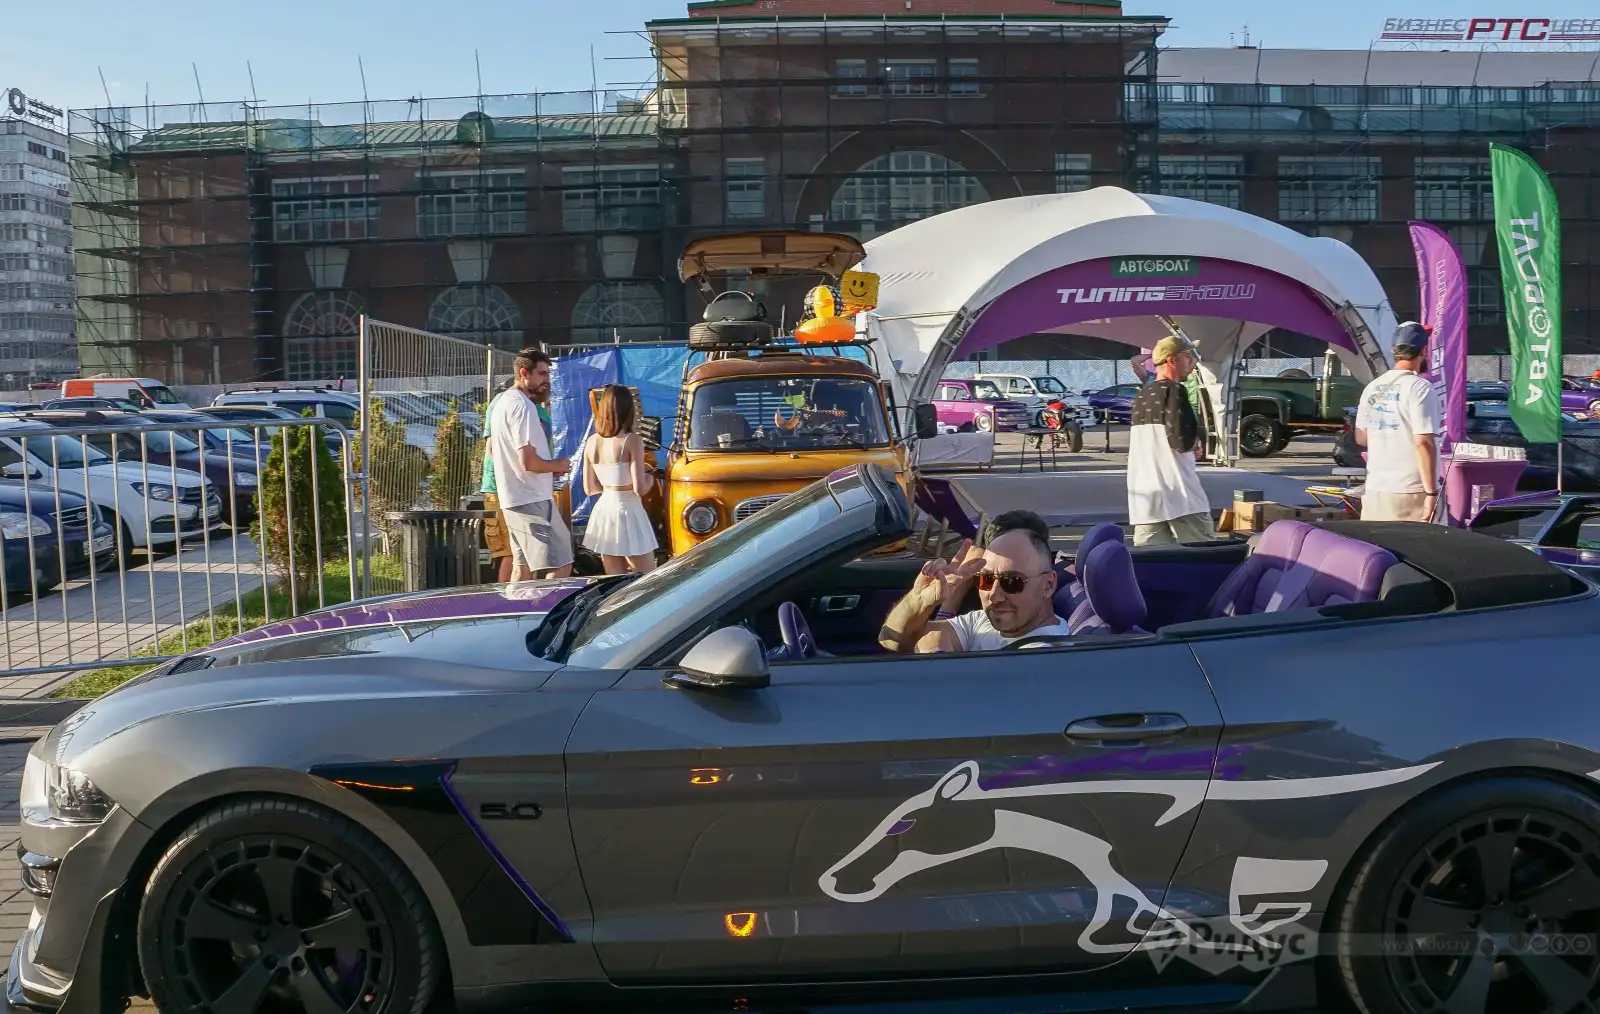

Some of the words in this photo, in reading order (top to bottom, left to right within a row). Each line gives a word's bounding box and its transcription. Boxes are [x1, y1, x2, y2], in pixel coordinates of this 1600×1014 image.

[1383, 17, 1467, 32] БИЗНЕС
[1466, 18, 1550, 40] РТС
[1119, 259, 1191, 273] АВТОБОЛТ
[480, 802, 543, 820] 5.0
